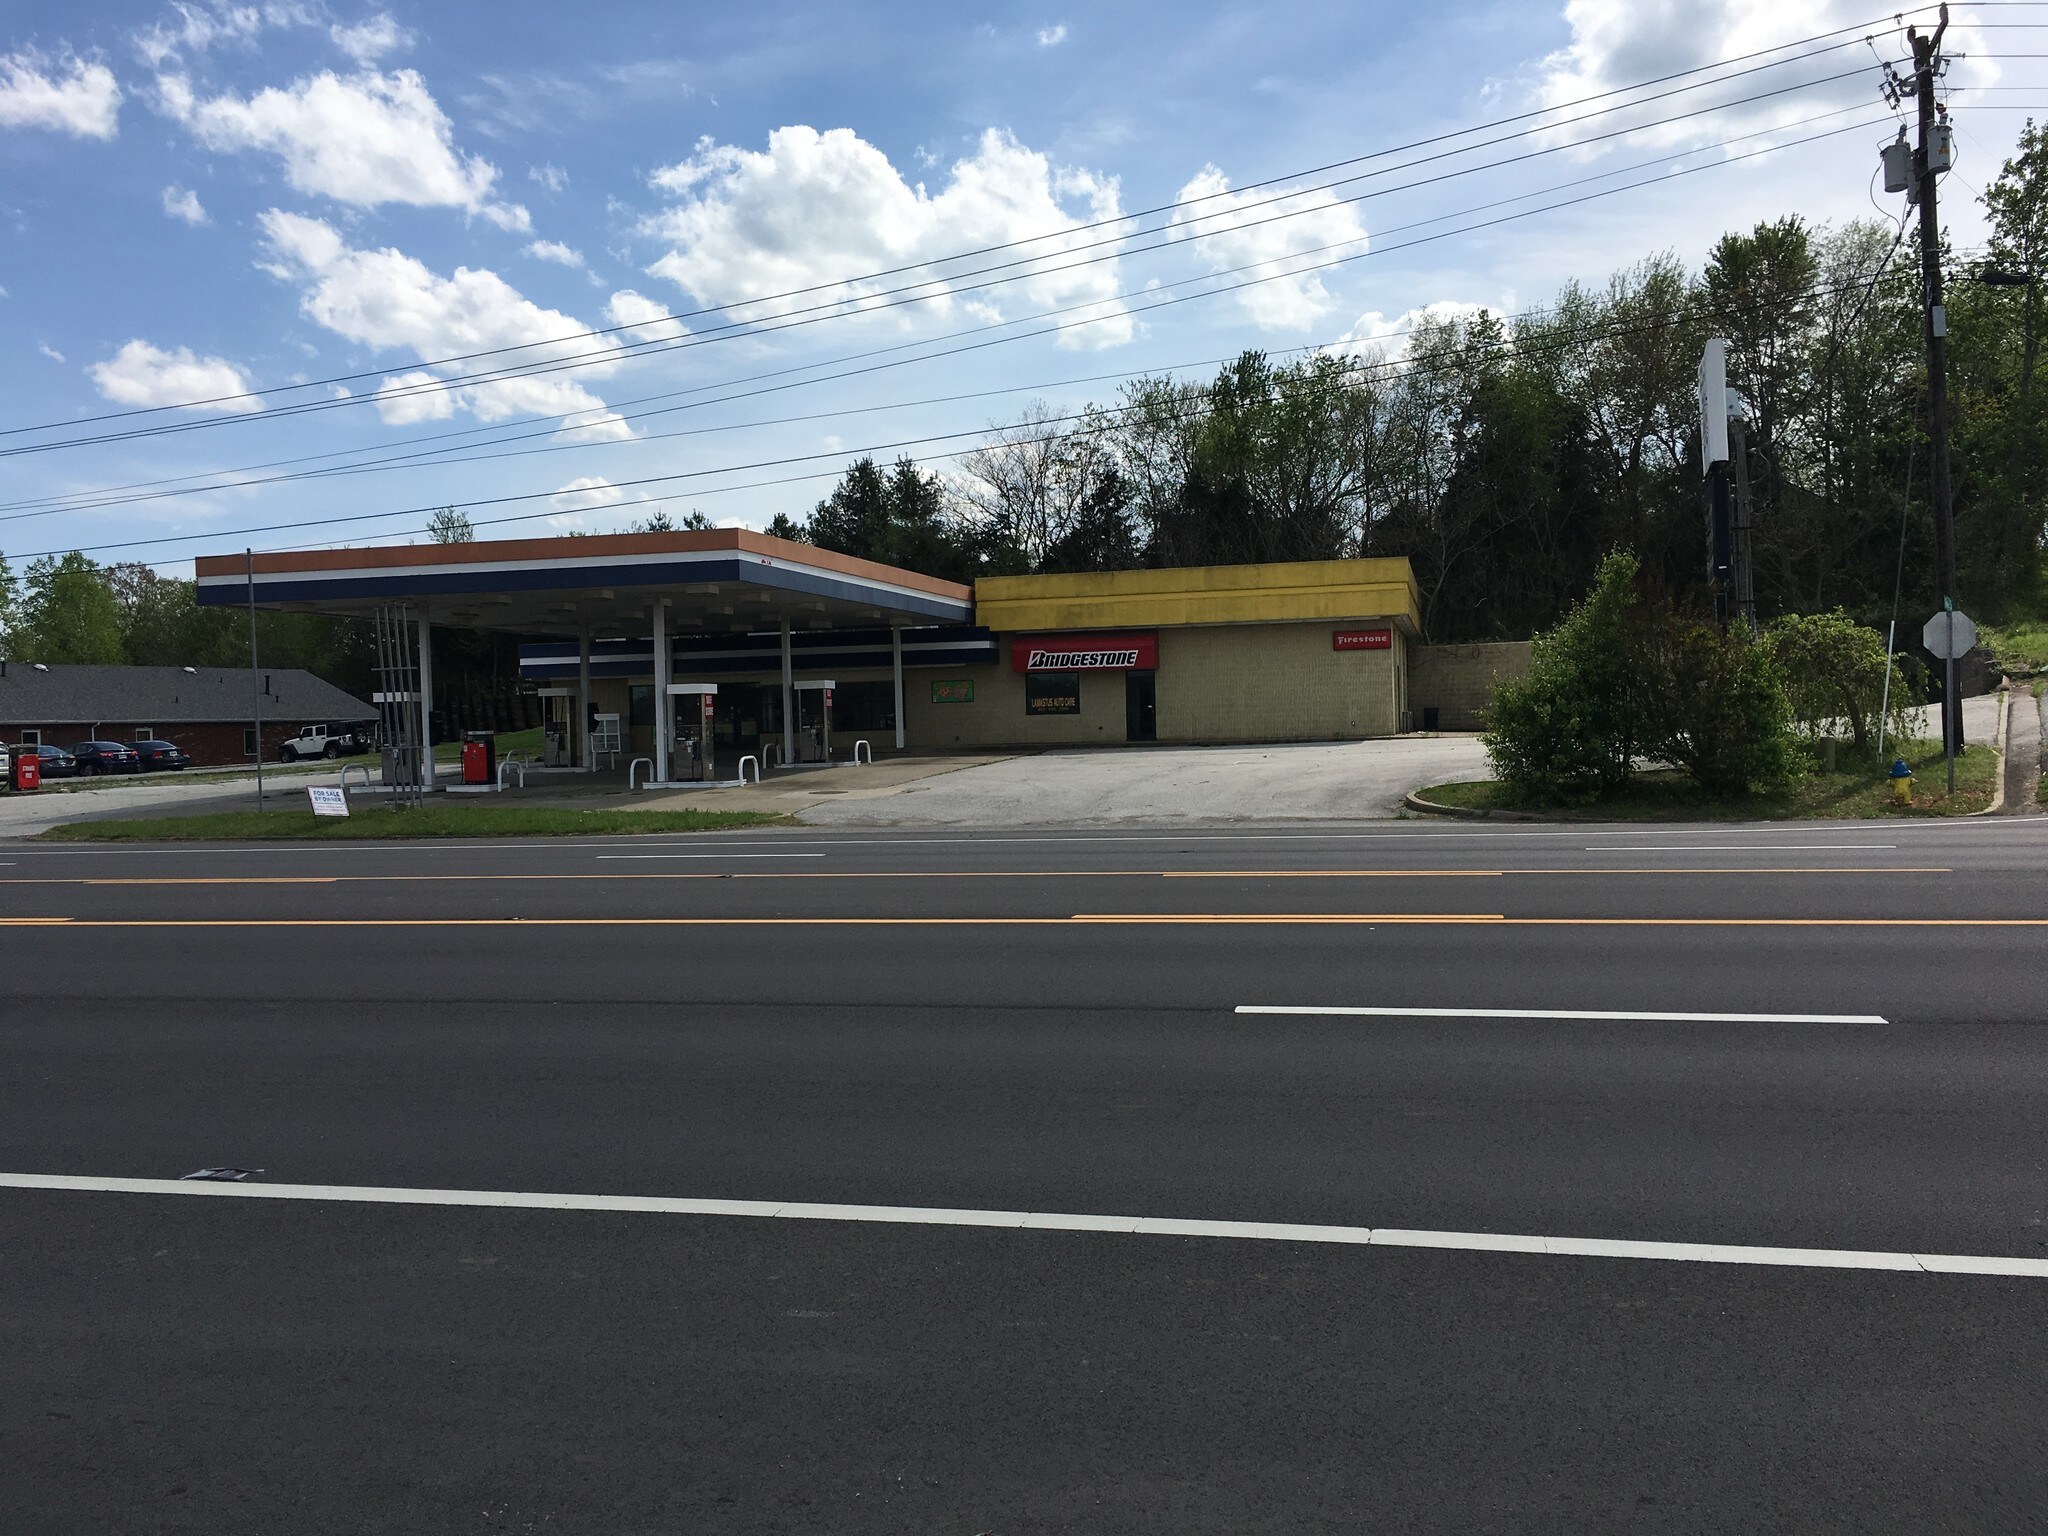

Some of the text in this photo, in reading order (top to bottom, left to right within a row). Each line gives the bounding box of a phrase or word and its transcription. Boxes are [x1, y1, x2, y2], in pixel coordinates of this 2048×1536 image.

[1337, 636, 1387, 645] Firestone
[1028, 651, 1138, 669] BRIDGESTONE
[1054, 697, 1064, 707] AUTO
[1065, 697, 1076, 706] CARE
